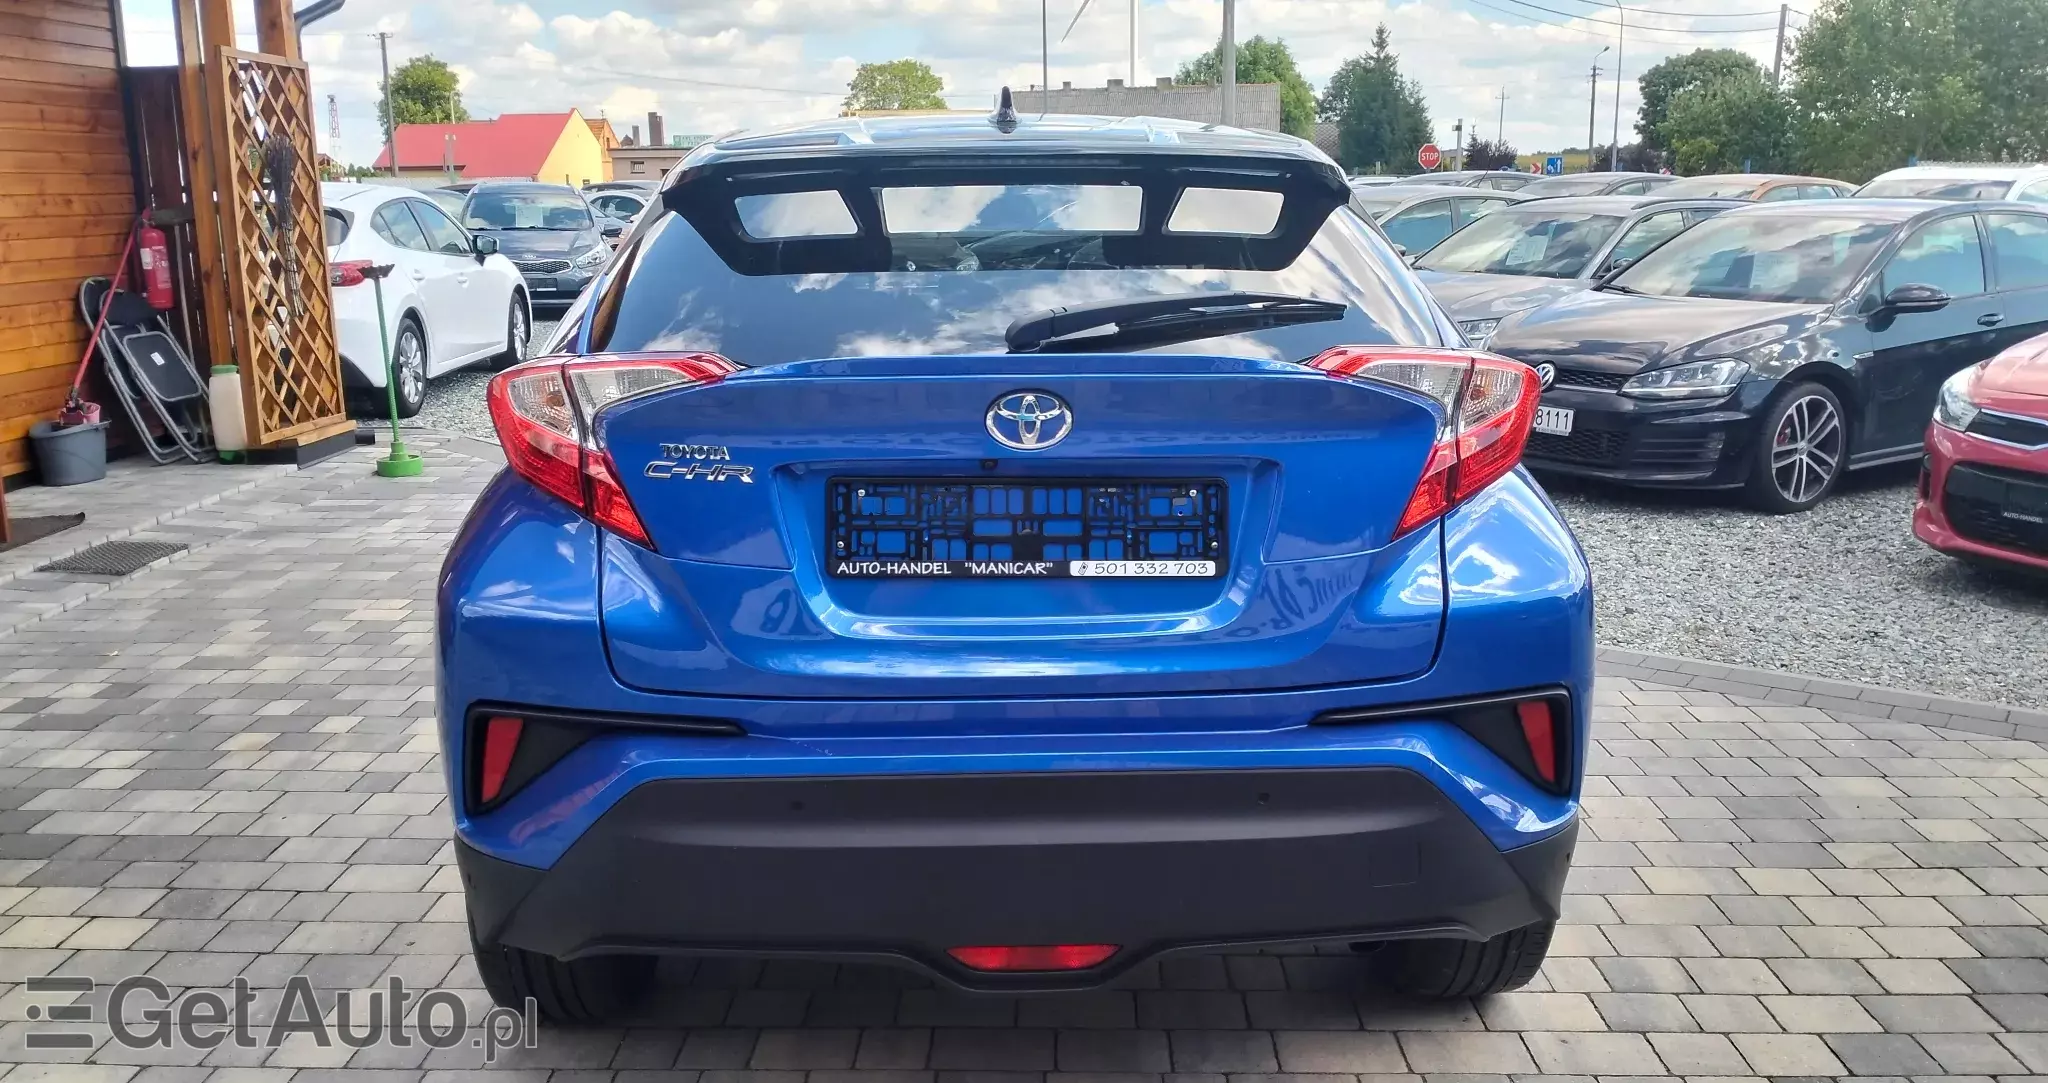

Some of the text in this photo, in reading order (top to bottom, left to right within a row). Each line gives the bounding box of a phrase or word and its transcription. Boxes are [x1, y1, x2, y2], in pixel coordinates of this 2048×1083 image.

[1421, 152, 1439, 161] STOP
[1536, 408, 1569, 430] 8111
[659, 442, 731, 461] TOYOTA
[643, 460, 754, 484] C-HR
[2002, 511, 2044, 524] AUTO-HANDEL
[836, 561, 1209, 575] AUTO-HANDEL "MANICAR" 501 332 703
